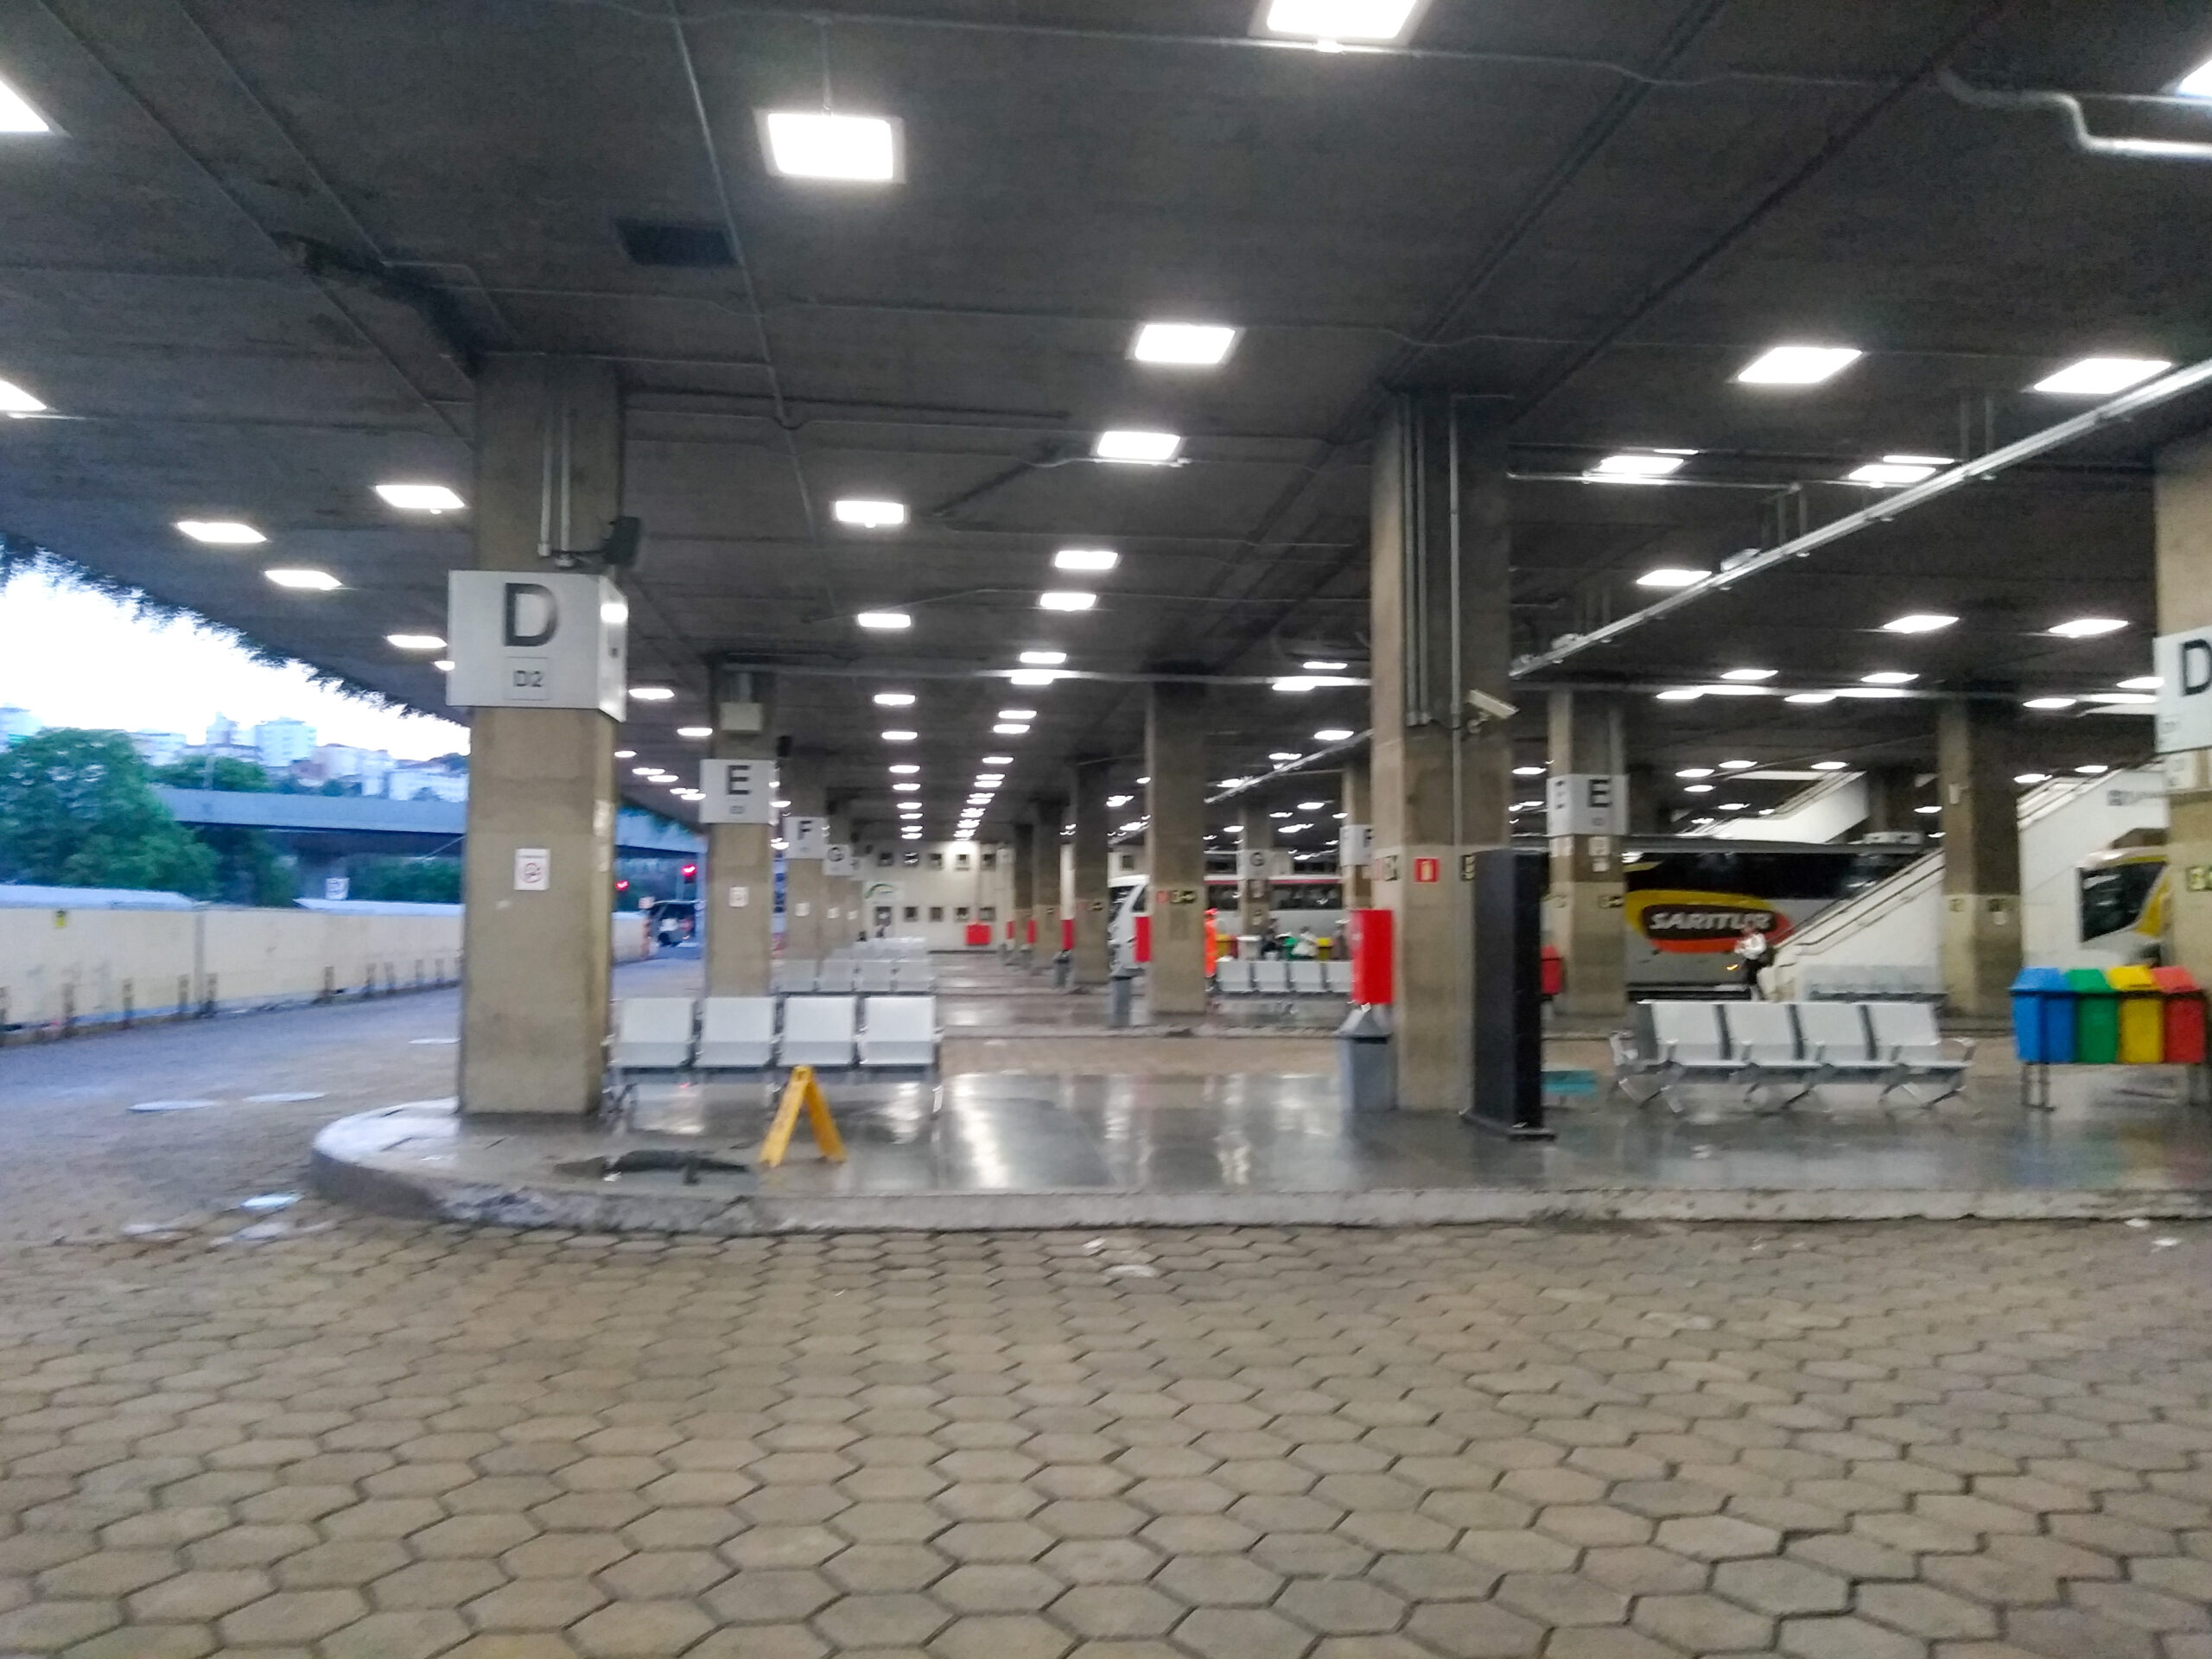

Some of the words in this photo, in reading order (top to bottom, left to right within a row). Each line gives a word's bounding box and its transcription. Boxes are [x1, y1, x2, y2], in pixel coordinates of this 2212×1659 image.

[504, 582, 559, 647] D
[512, 670, 544, 688] D2
[2179, 639, 2212, 696] D
[727, 765, 750, 795] E
[1588, 779, 1612, 808] E
[798, 820, 813, 841] F
